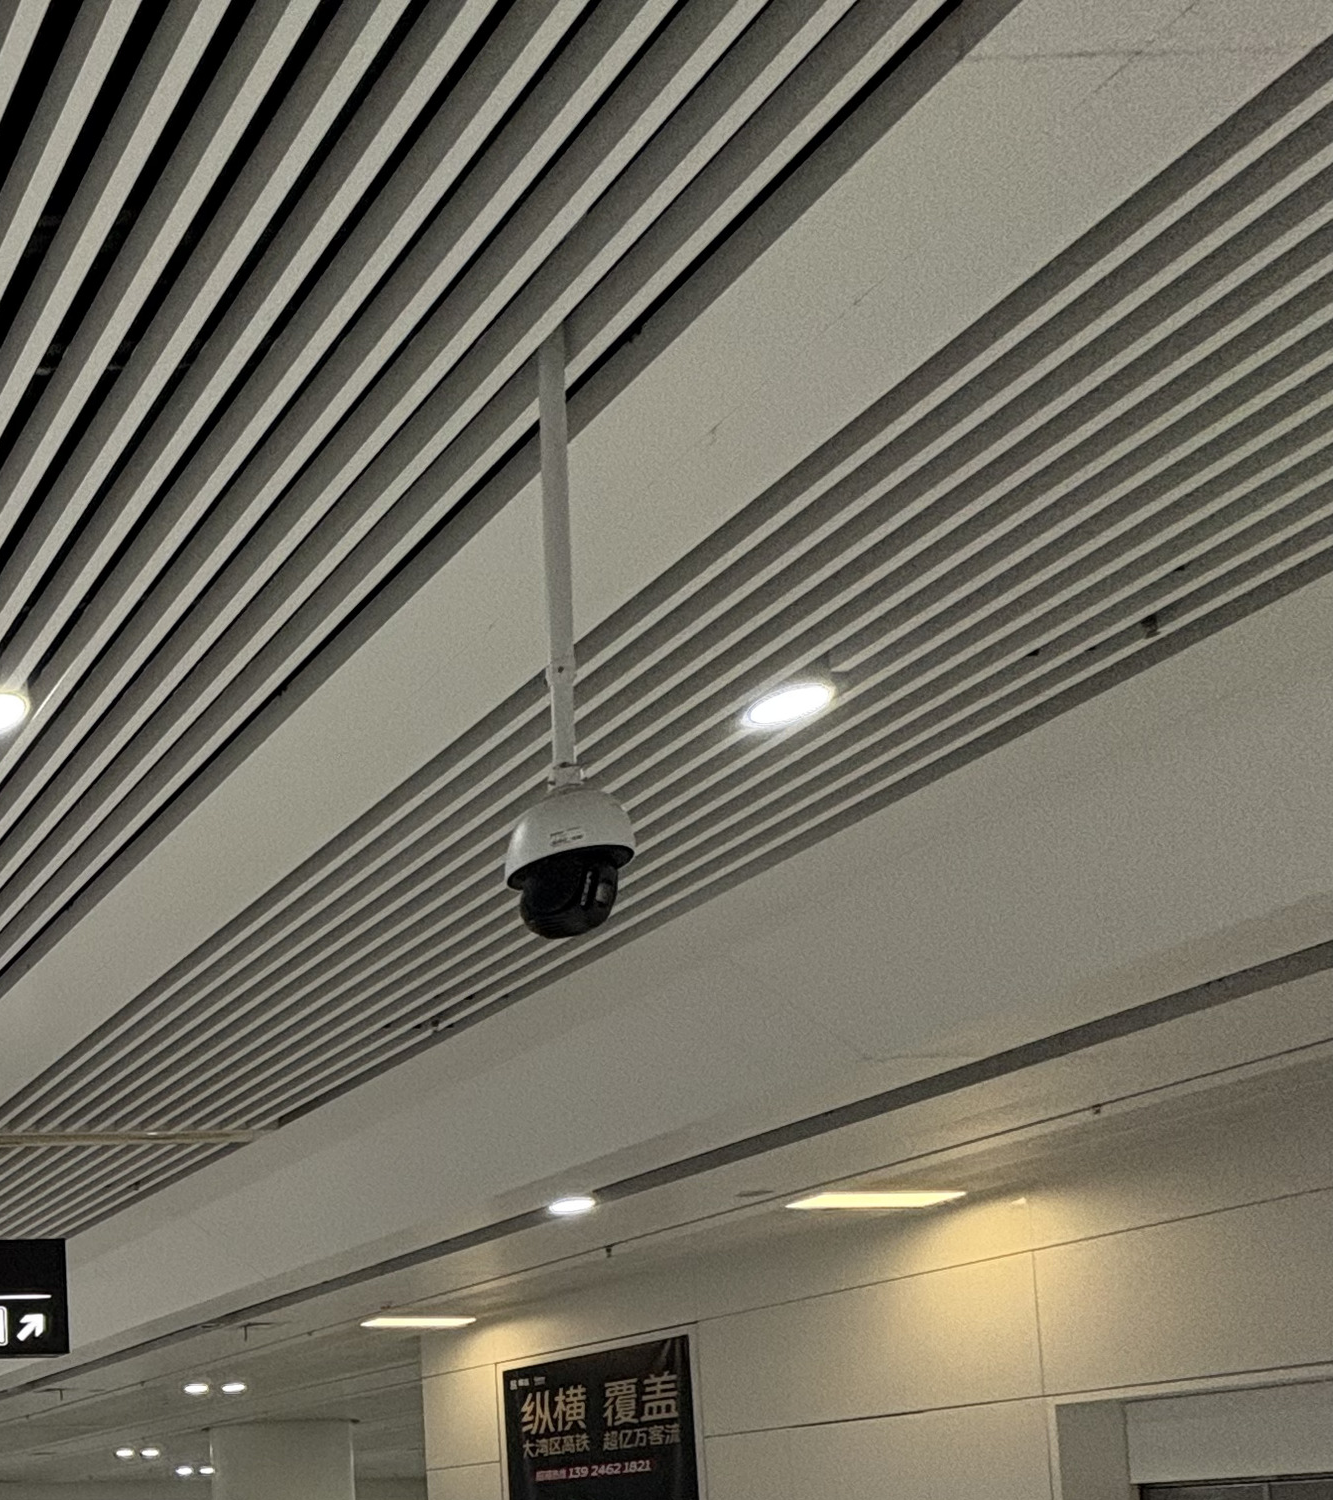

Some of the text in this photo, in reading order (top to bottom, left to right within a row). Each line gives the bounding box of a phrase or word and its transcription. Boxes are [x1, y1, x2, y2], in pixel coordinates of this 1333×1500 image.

[521, 1371, 680, 1435] 纵横 覆盖
[523, 1423, 681, 1459] 大湾区高铁 超亿万客流
[569, 1466, 589, 1479] 139
[591, 1463, 622, 1477] 2462
